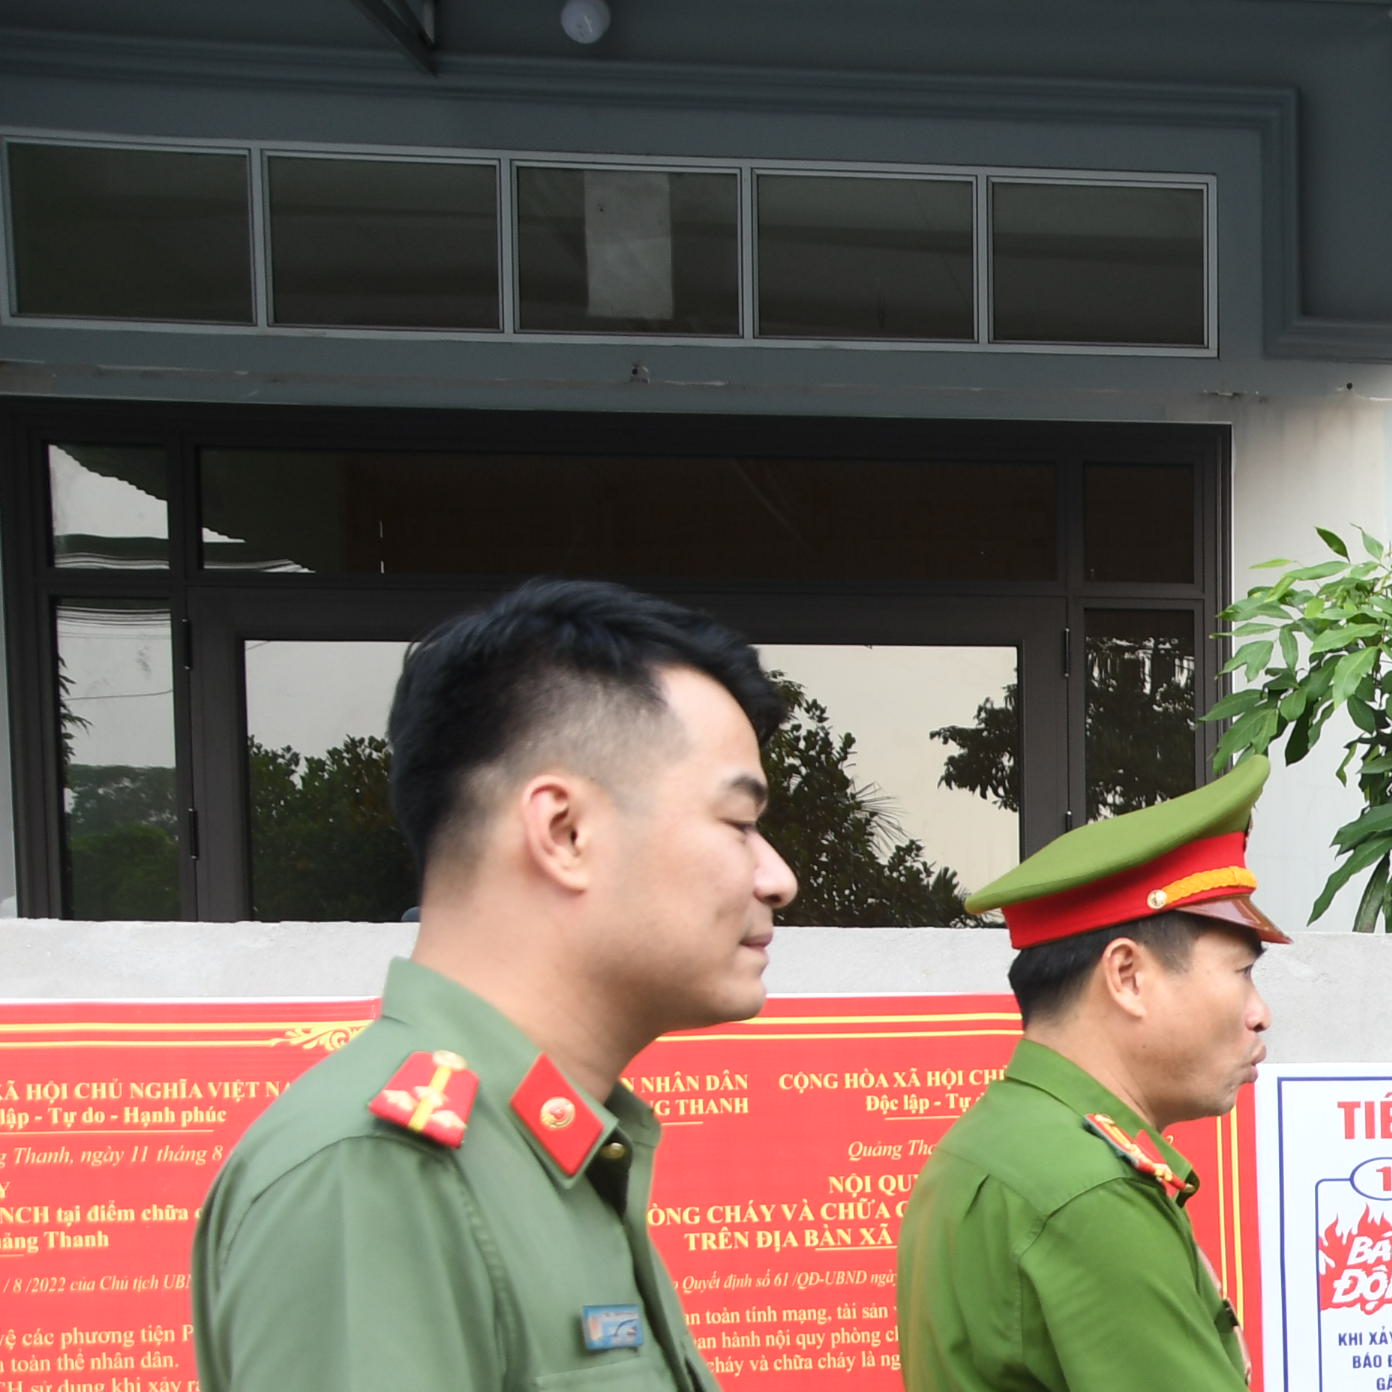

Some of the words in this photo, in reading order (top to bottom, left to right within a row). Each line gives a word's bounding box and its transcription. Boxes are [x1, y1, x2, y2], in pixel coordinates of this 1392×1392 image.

[26, 1081, 68, 1104] HỘI
[73, 1078, 123, 1100] CHỦ
[129, 1078, 204, 1099] NGHĨA
[207, 1080, 260, 1103] VIỆT
[640, 1070, 700, 1093] NHÂN
[705, 1069, 748, 1091] DÂN
[778, 1071, 839, 1093] CỘNG
[893, 1067, 921, 1088] XÃ
[926, 1068, 964, 1090] HỘI
[674, 1097, 749, 1116] THANH
[865, 1094, 899, 1115] Độc
[903, 1093, 930, 1114] lập
[945, 1092, 971, 1114] Tự
[0, 1108, 30, 1130] lập
[47, 1107, 78, 1128] Tự
[81, 1106, 106, 1124] do
[123, 1106, 176, 1128] Hạnh
[180, 1106, 227, 1128] phúc
[80, 1145, 125, 1167] ngày
[130, 1145, 149, 1163] 11
[156, 1145, 208, 1166] tháng
[211, 1145, 224, 1160] 8
[828, 1173, 872, 1198] NỘI
[1376, 1166, 1392, 1191] 1
[56, 1205, 81, 1227] tại
[706, 1199, 776, 1224] CHÁY
[820, 1197, 891, 1221] CHỮA
[43, 1230, 110, 1249] Thanh
[683, 1226, 749, 1251] TRÊN
[756, 1230, 799, 1253] ĐỊA
[859, 1226, 894, 1248] XÃ
[773, 1272, 789, 1286] 61
[795, 1333, 826, 1350] quy
[1338, 1332, 1363, 1346] KHI
[90, 1352, 135, 1370] nhân
[139, 1351, 179, 1369] dân.
[817, 1351, 856, 1373] cháy
[1352, 1352, 1382, 1369] BÁO
